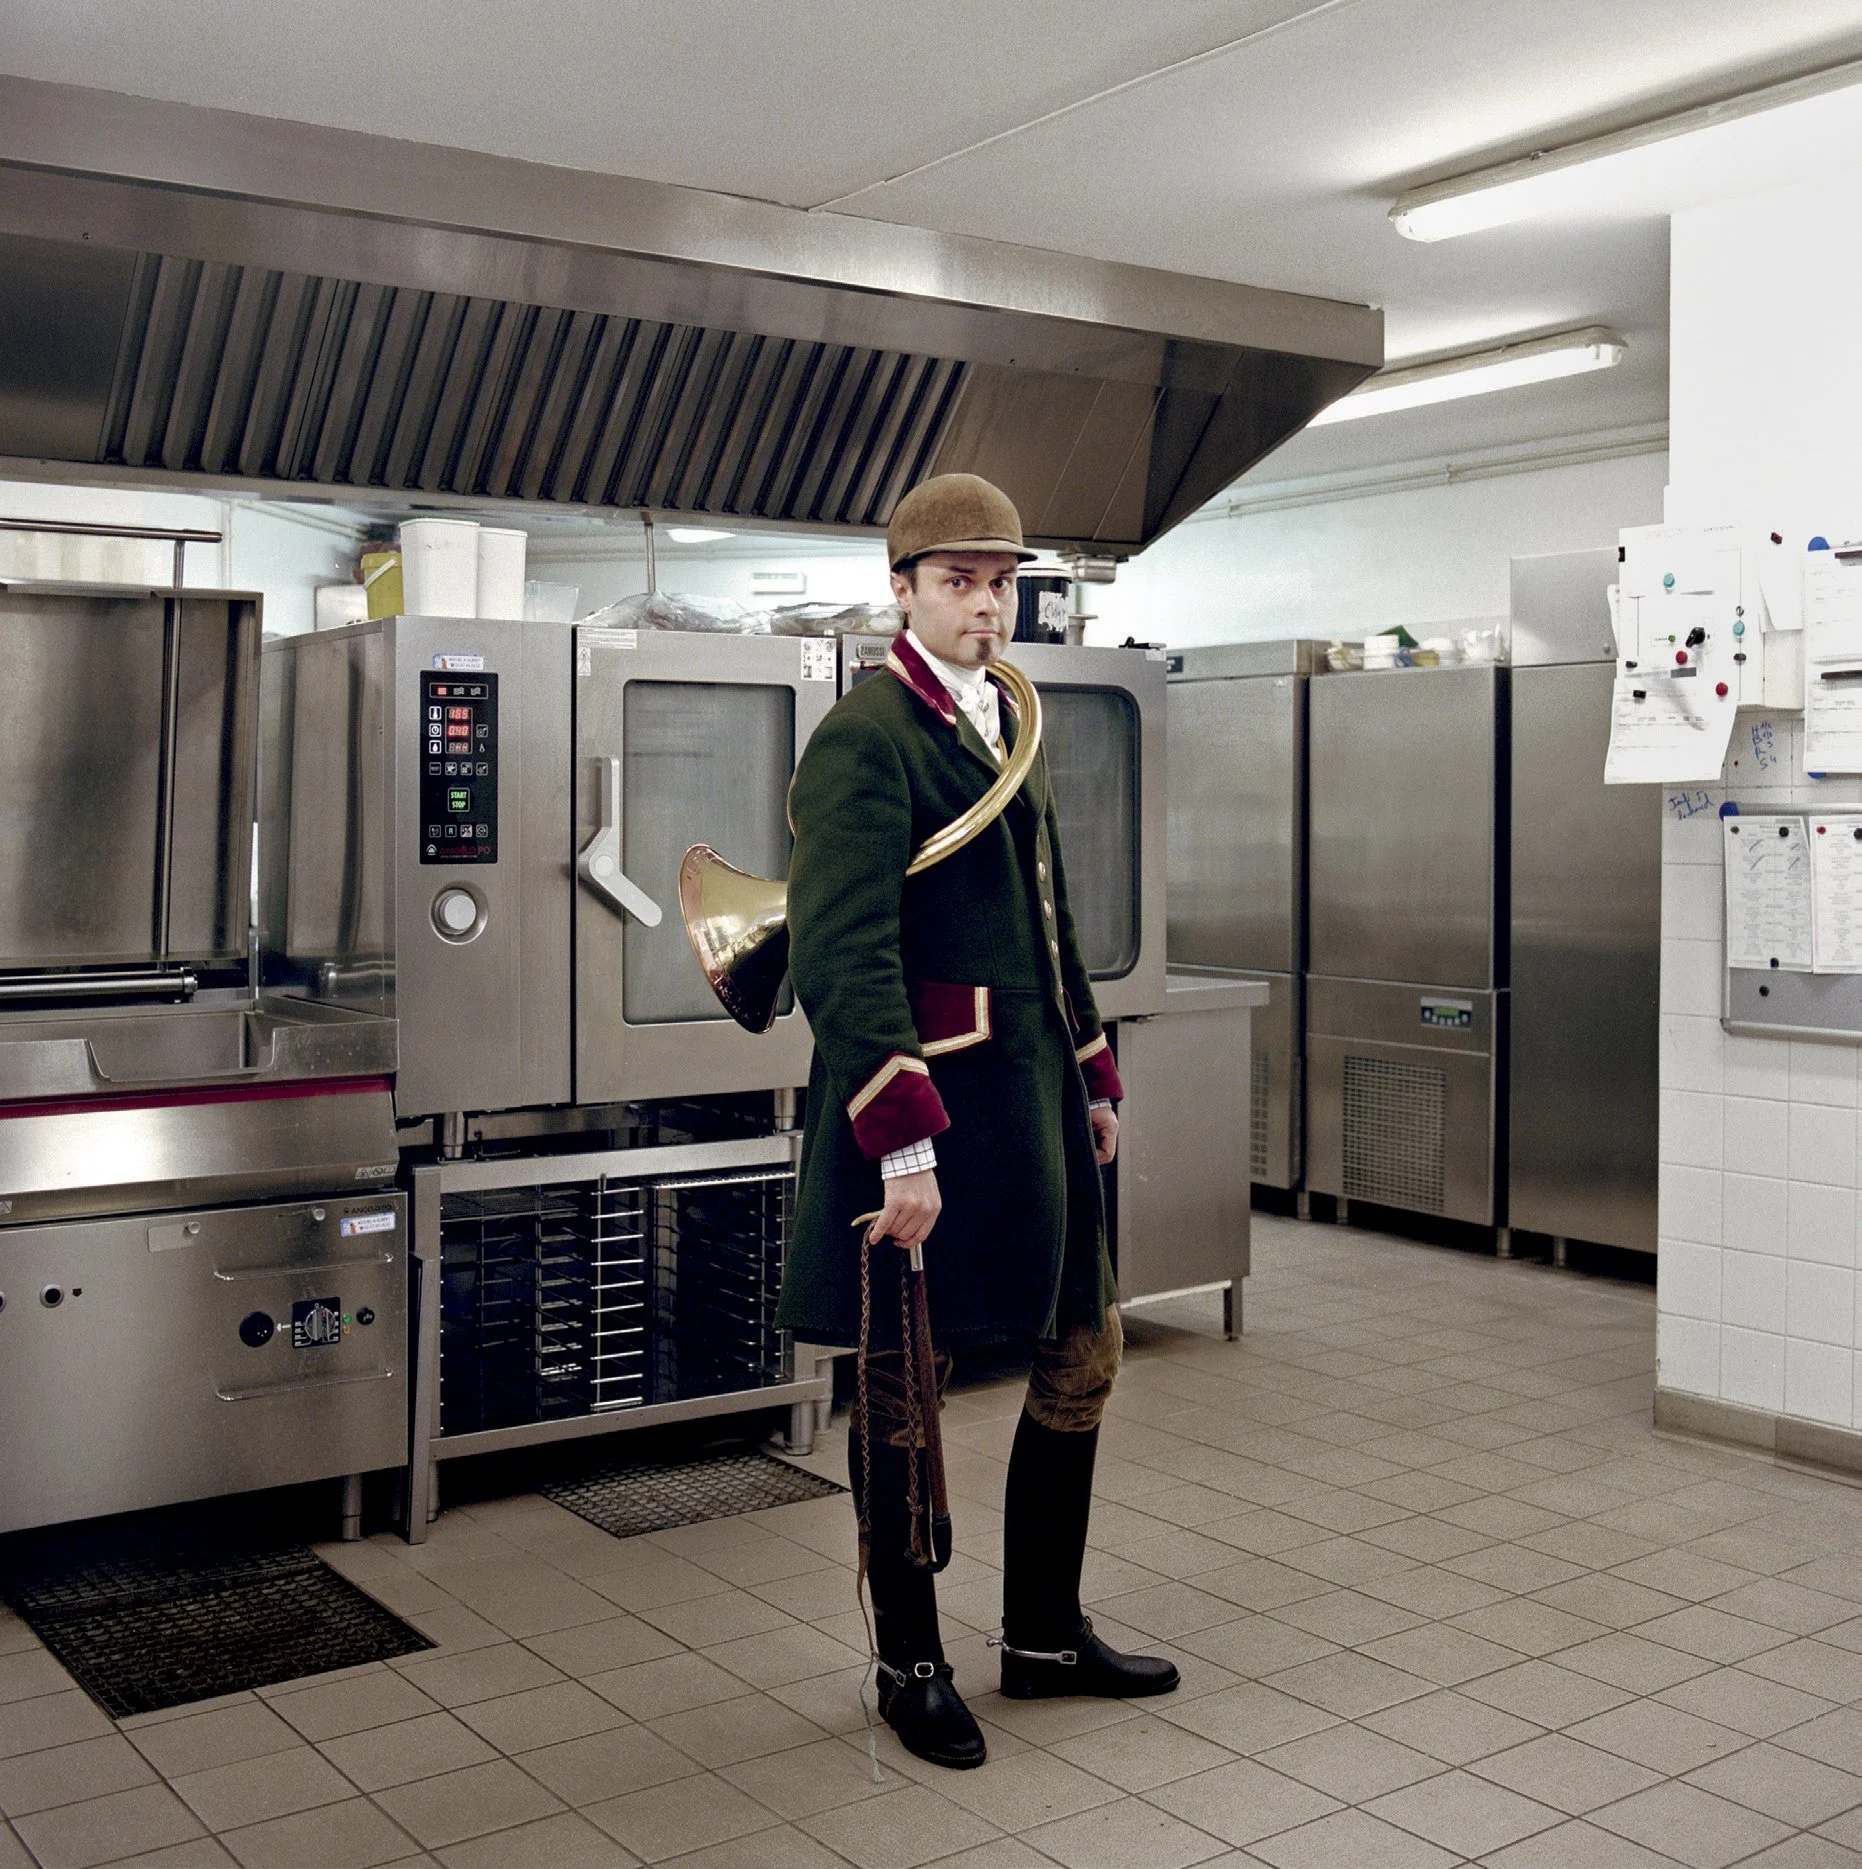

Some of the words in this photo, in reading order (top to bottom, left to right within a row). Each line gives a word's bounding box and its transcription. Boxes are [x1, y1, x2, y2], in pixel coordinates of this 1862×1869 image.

[860, 646, 885, 656] ZANUSSI
[450, 791, 467, 800] START
[452, 800, 466, 810] STOP
[439, 846, 477, 855] ANGELO
[477, 845, 492, 855] PO
